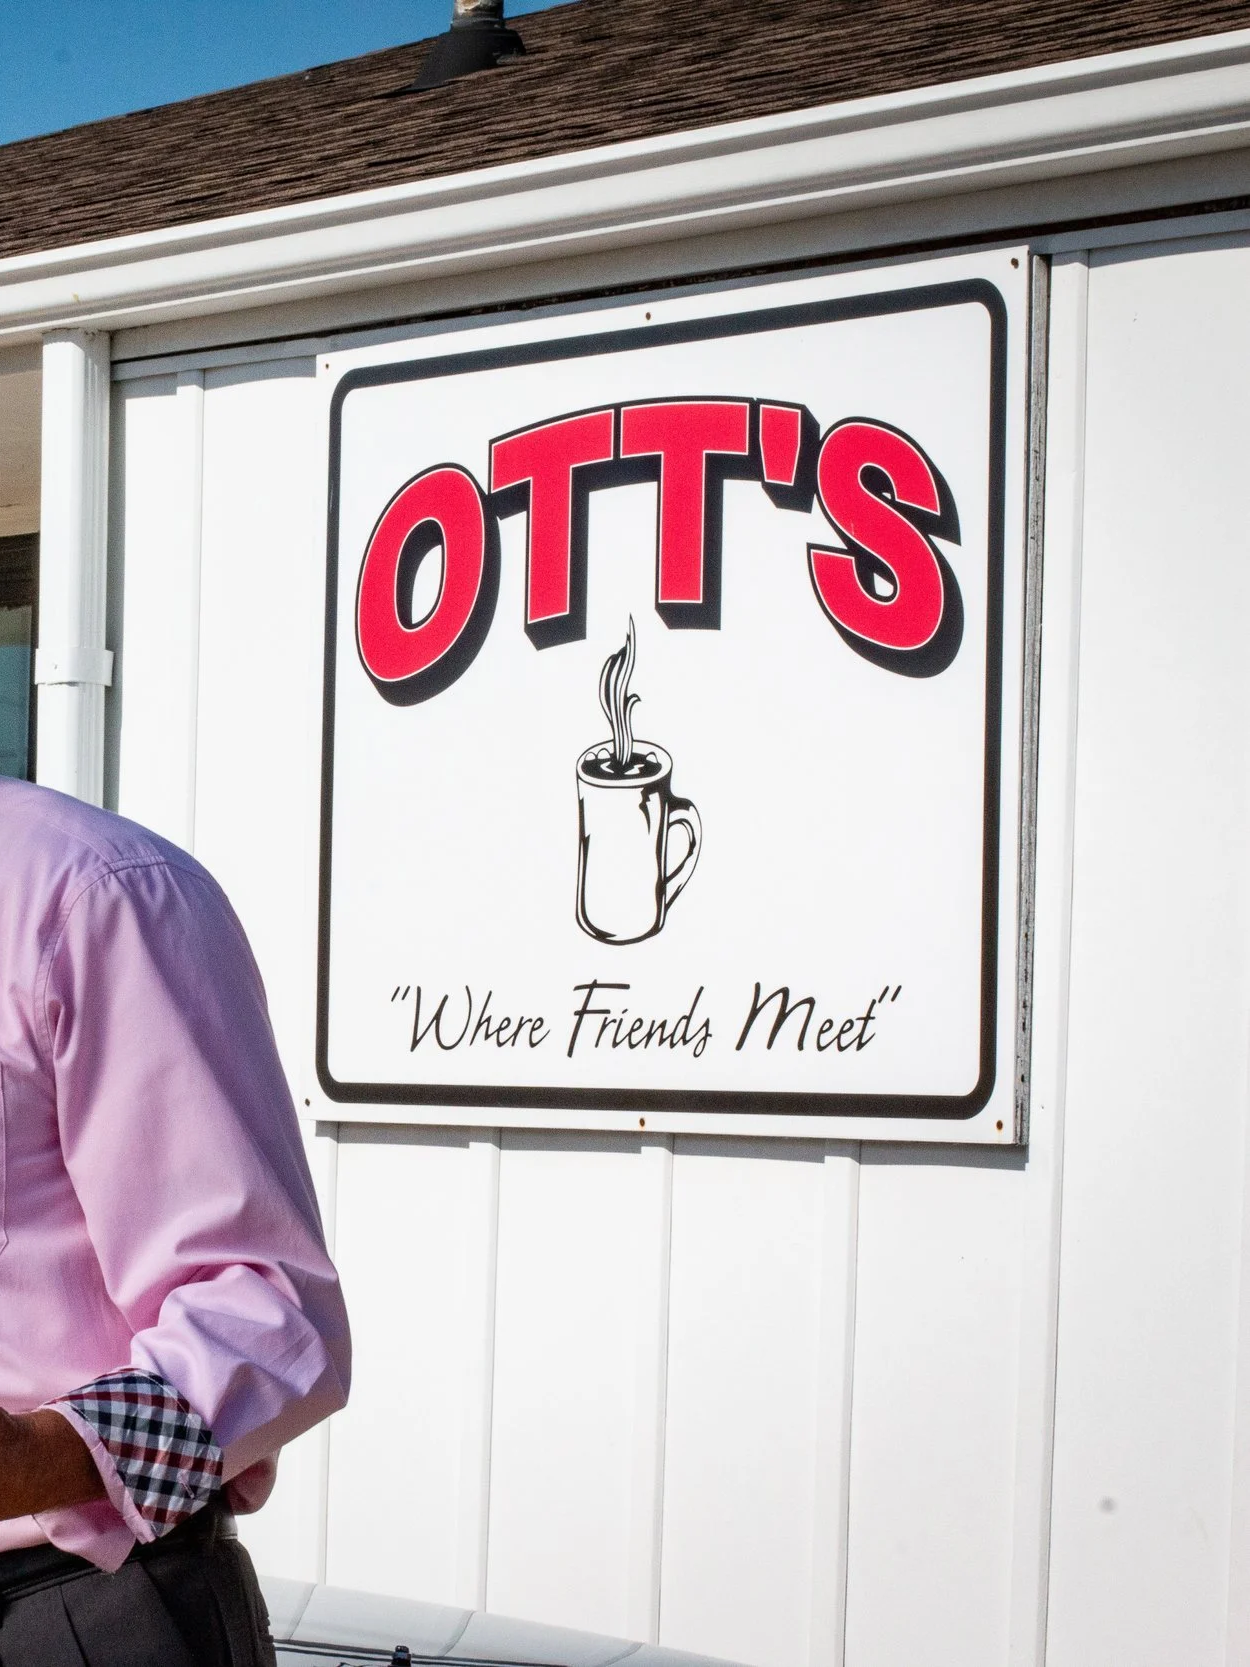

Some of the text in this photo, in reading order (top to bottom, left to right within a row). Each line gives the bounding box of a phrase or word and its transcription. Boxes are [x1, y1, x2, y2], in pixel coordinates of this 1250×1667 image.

[354, 395, 965, 707] OTT'S
[390, 978, 903, 1059] "Where Friends Meet"
